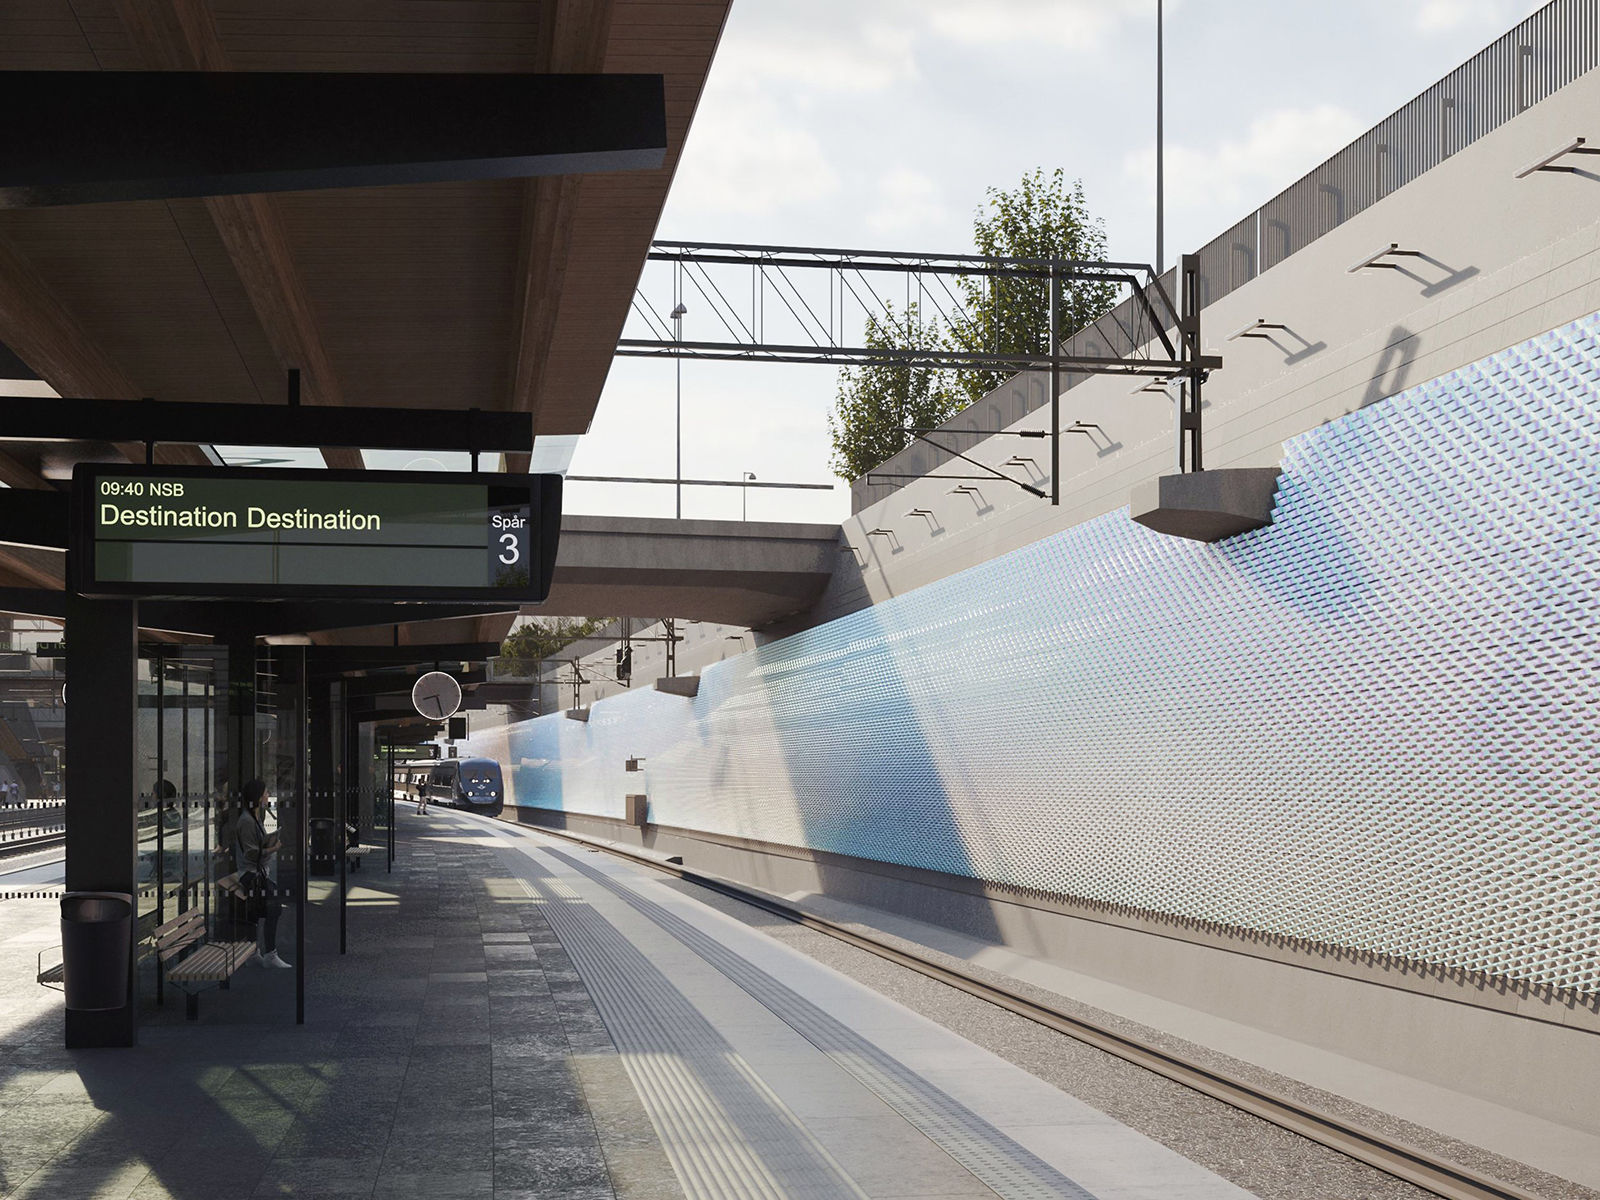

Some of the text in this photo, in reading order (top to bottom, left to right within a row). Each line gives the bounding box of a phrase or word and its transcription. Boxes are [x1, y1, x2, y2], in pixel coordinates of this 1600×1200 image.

[100, 481, 185, 497] 09:40 NSB
[101, 503, 381, 531] Destination Destination
[492, 514, 526, 531] Spår
[498, 533, 520, 565] 3
